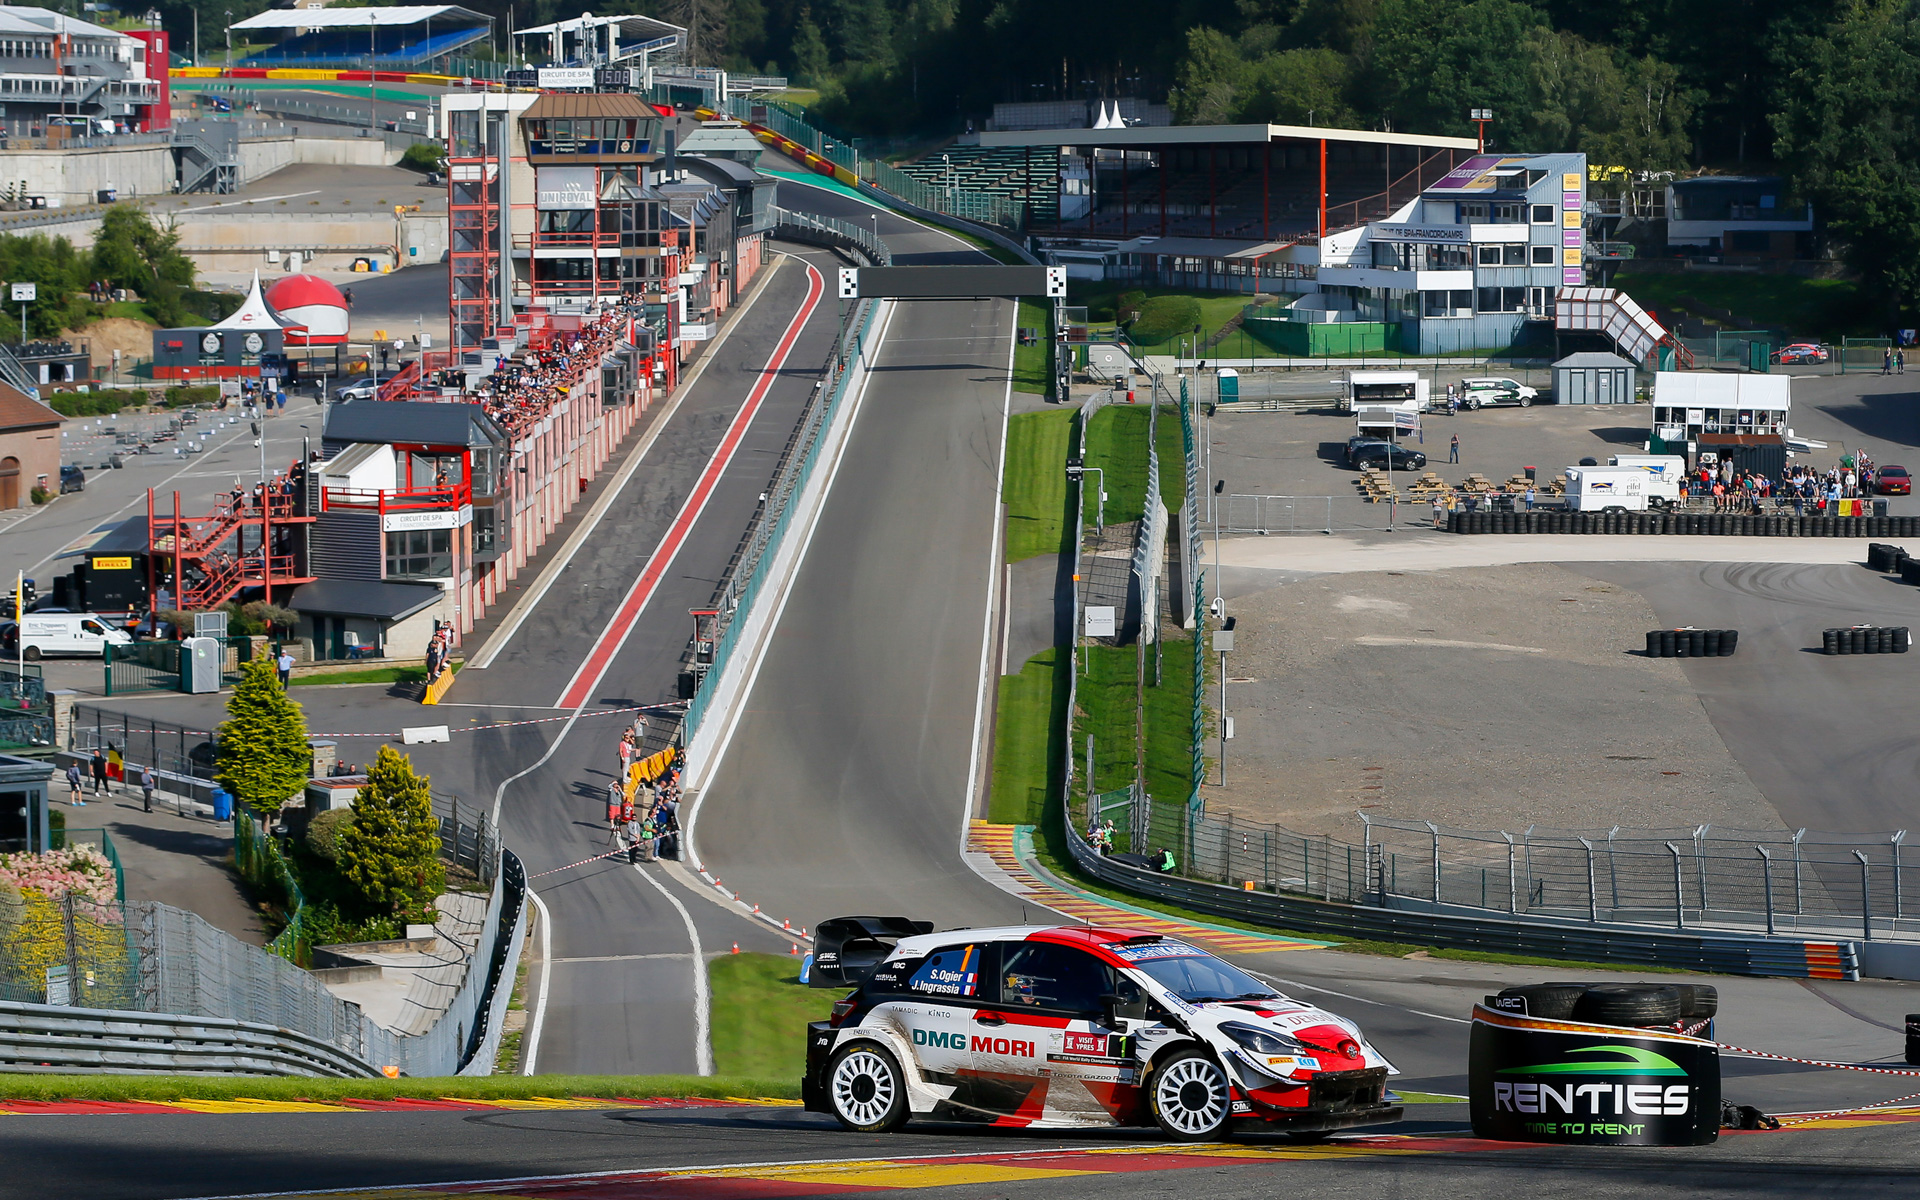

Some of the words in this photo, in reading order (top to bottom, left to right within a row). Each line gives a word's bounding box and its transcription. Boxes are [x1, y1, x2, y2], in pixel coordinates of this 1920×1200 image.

[541, 192, 593, 203] UNIROYAL
[1626, 482, 1641, 490] eifel
[960, 944, 975, 972] 1
[930, 969, 963, 983] S.Ogier
[911, 980, 960, 995] J.Ingrassia
[891, 1006, 918, 1014] TAMADIC
[1495, 998, 1521, 1008] WRC
[912, 1029, 966, 1050] DMG
[971, 1036, 1035, 1058] MORI
[1078, 1036, 1094, 1044] VISIT
[1119, 1036, 1127, 1058] 1
[1076, 1043, 1095, 1052] YPRES
[1494, 1081, 1689, 1115] RENTIES
[1525, 1122, 1557, 1134] TIME
[1561, 1123, 1585, 1134] TO
[1590, 1123, 1646, 1136] RENT
